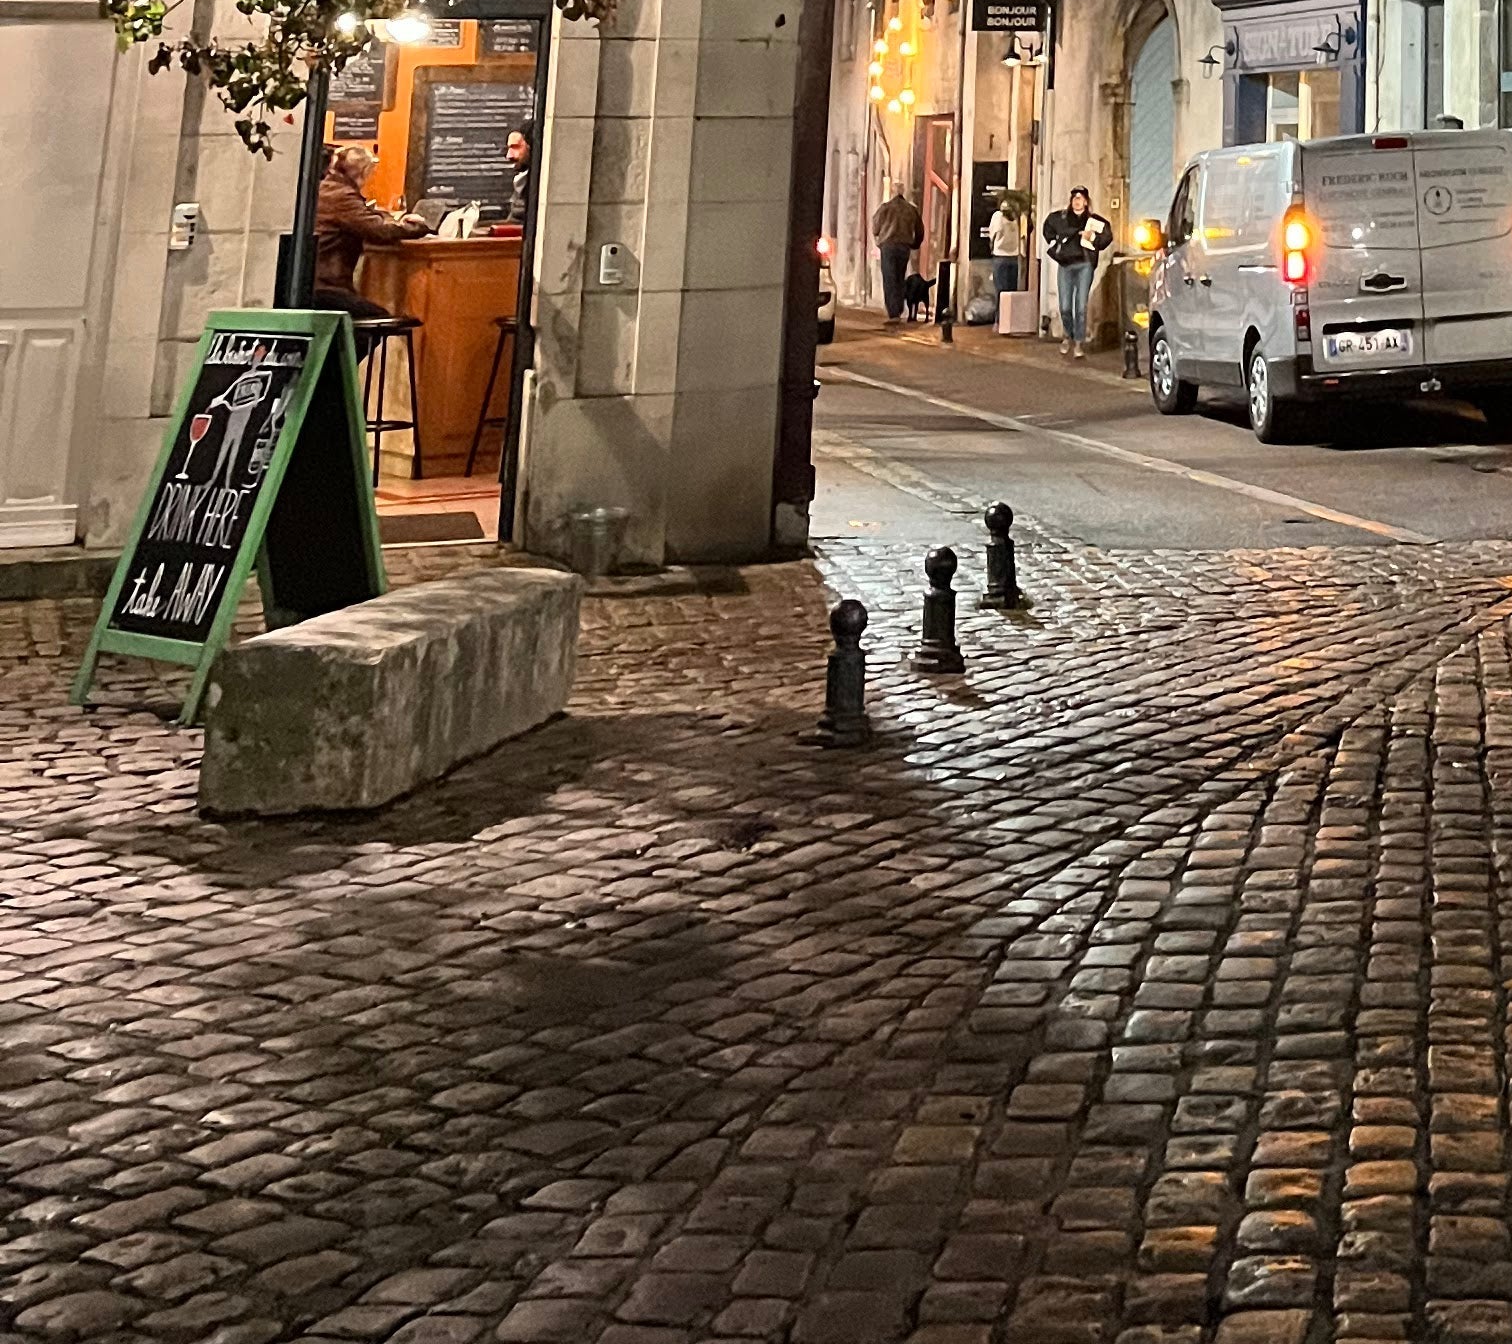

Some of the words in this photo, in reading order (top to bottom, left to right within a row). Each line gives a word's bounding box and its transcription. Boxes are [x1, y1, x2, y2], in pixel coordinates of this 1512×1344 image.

[986, 16, 1036, 26] BONJOUR
[987, 5, 1037, 15] BONJOUR
[196, 486, 250, 549] HERE
[121, 562, 164, 618] take
[162, 562, 226, 626] AWAY
